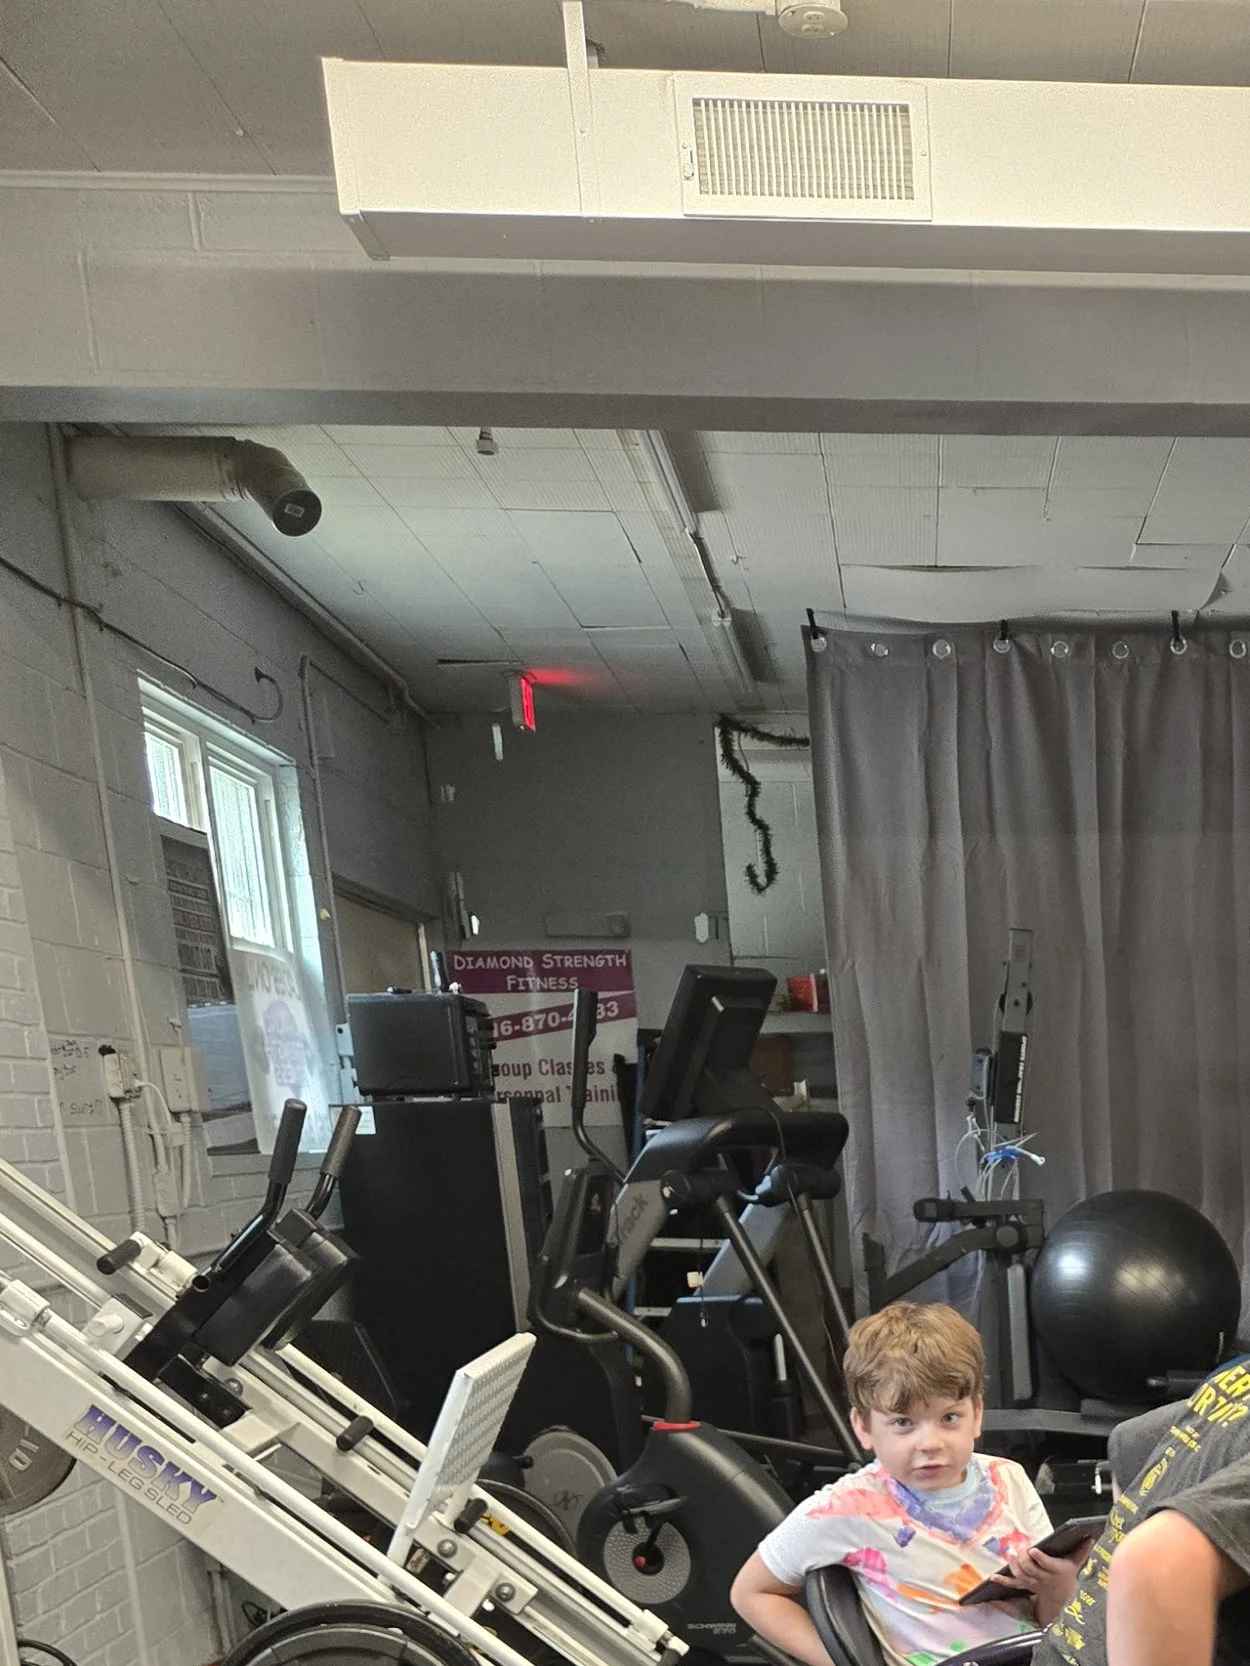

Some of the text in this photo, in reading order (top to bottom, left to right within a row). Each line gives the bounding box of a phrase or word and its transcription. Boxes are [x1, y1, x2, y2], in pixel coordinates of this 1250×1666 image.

[453, 953, 627, 970] DIAMOND STRENGTH
[506, 975, 579, 991] FITNESS
[538, 1058, 606, 1076] Clases
[74, 1404, 218, 1514] HUSKY
[144, 1487, 193, 1525] SLED
